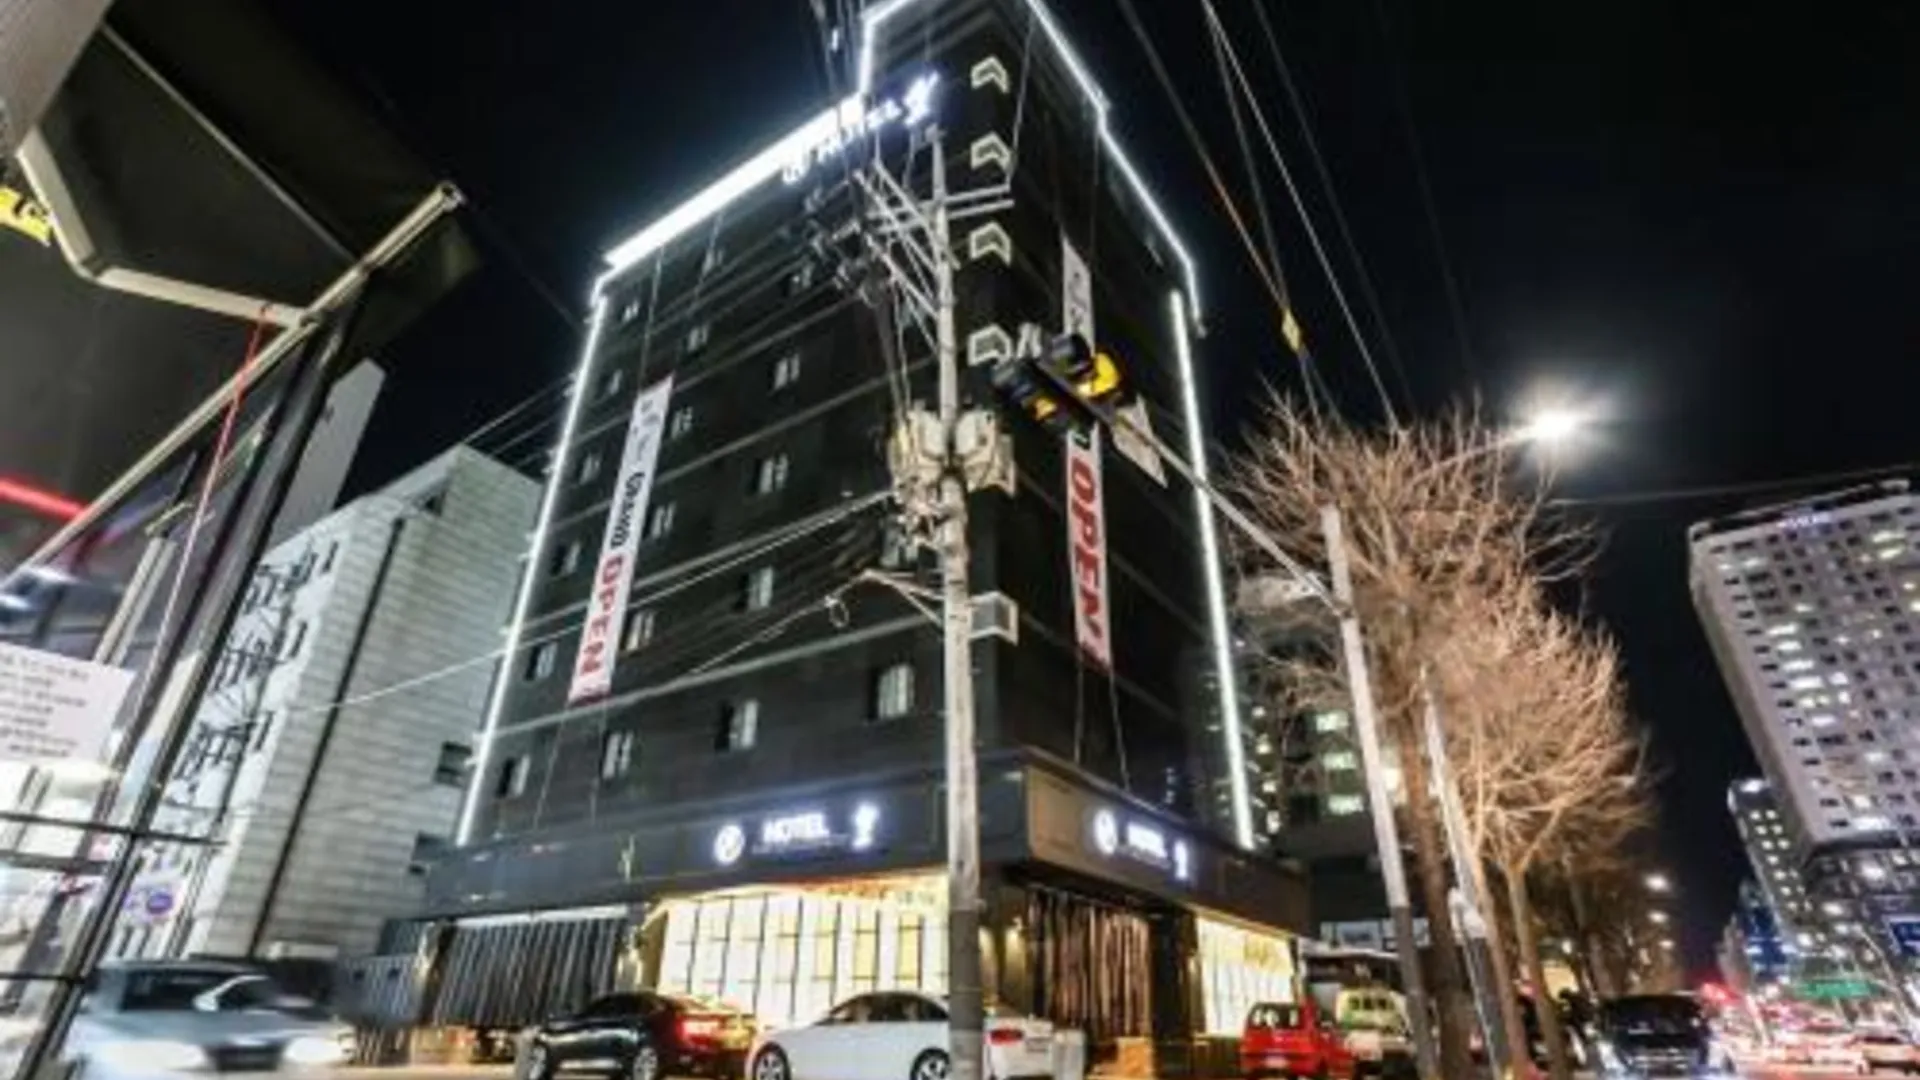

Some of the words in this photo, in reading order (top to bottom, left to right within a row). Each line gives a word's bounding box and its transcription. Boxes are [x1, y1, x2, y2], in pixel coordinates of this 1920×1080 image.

[1071, 457, 1103, 640] OPEN
[579, 554, 623, 676] OPEN
[763, 811, 829, 845] HOTEL
